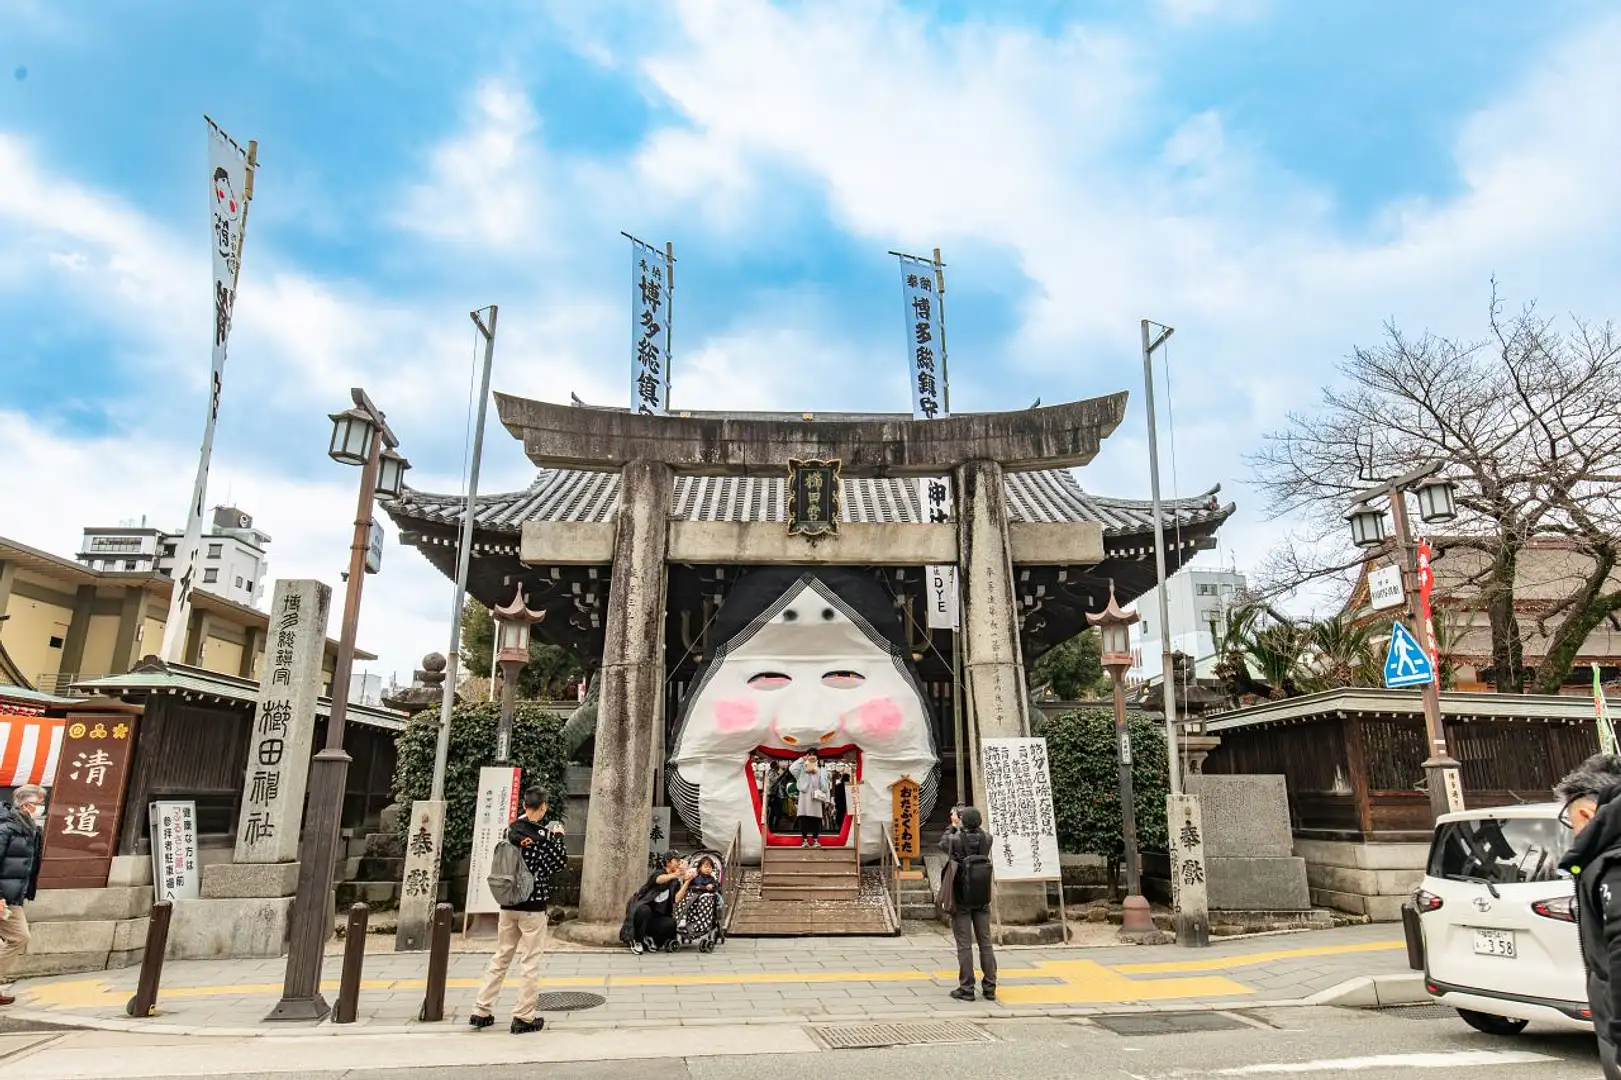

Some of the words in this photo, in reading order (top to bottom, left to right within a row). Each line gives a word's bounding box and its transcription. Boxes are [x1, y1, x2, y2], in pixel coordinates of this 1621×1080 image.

[906, 273, 932, 293] 奉納
[934, 577, 948, 613] DYE
[61, 748, 113, 838] 清道
[900, 786, 913, 853] おたふくわた
[182, 807, 194, 871] 健康な方は
